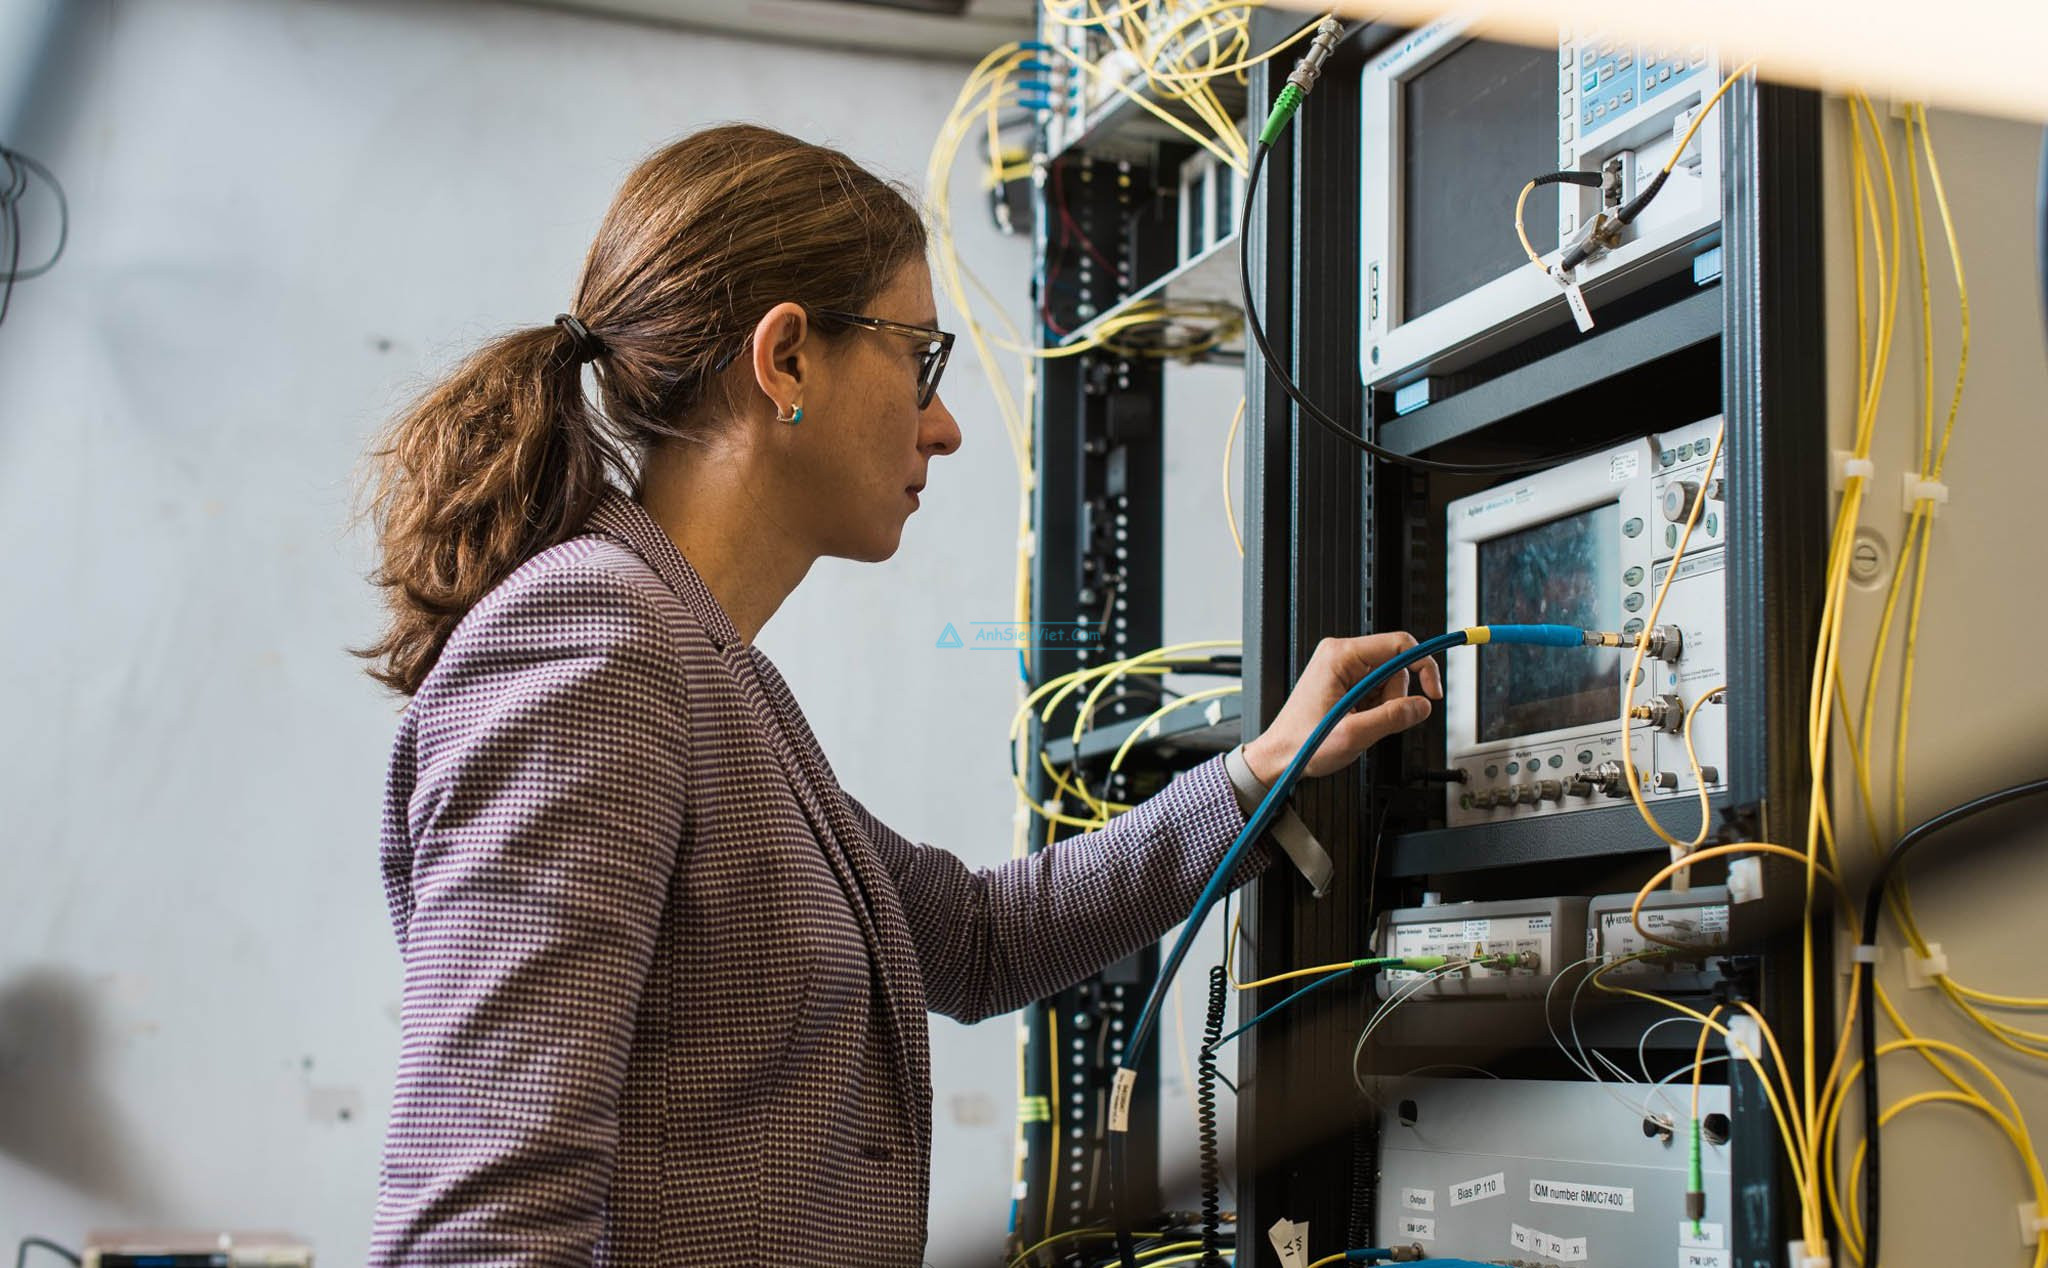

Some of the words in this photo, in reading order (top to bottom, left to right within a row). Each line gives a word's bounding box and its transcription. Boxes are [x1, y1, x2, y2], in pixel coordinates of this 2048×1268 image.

[1457, 1187, 1473, 1200] Bias
[1474, 1183, 1483, 1195] IP
[1483, 1180, 1496, 1193] 110
[1534, 1183, 1548, 1197] QM
[1550, 1186, 1579, 1201] number
[1410, 1194, 1426, 1206] Output
[1515, 1231, 1525, 1242] YQ
[1551, 1243, 1561, 1253] XQ
